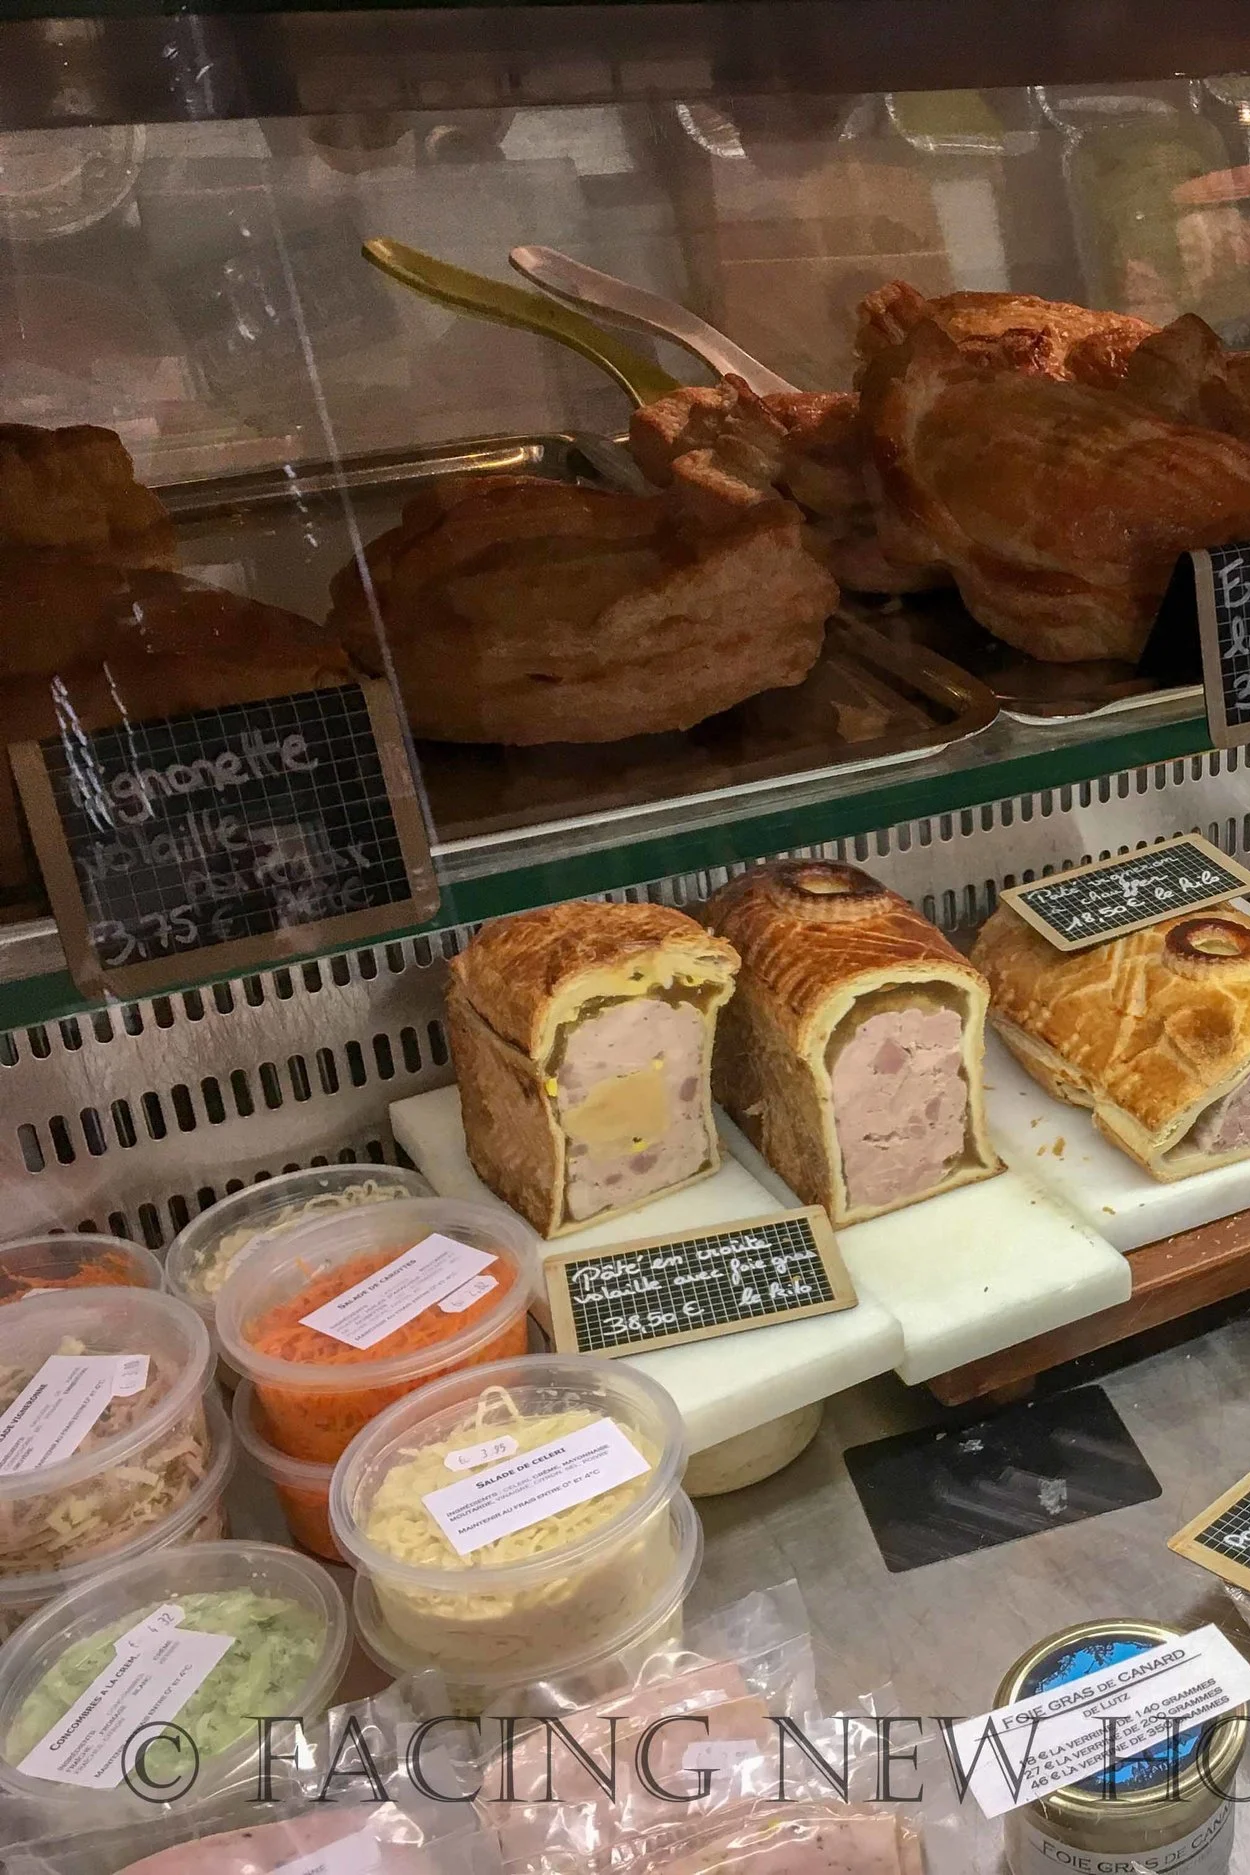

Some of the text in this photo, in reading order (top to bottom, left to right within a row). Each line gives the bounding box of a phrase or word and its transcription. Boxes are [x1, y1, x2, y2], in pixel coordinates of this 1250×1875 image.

[1081, 874, 1169, 905] chauffer
[574, 1250, 818, 1304] volaille avec foie gras
[650, 1254, 683, 1270] en
[695, 1234, 773, 1261] croûte
[603, 1281, 813, 1336] 38,50 € le kilo
[475, 1447, 566, 1490] SALADE DE CELERI
[49, 1695, 102, 1752] CONCOMBRES
[107, 1678, 119, 1690] LA
[1003, 1648, 1187, 1730] FOIE GRAS DE CANARD
[1049, 1741, 1066, 1756] LA
[1065, 1721, 1118, 1750] VERRINE
[1117, 1713, 1135, 1729] DE
[1134, 1702, 1160, 1719] 140
[1161, 1677, 1217, 1708] GRAMMES
[1082, 1692, 1131, 1719] DE LUTZ
[1023, 1766, 1042, 1780] 27
[1055, 1753, 1072, 1767] LA
[1072, 1733, 1123, 1761] VERRINE
[1123, 1724, 1141, 1739] DE
[1140, 1711, 1168, 1728] 200
[1167, 1686, 1223, 1715] GRAMMES
[1030, 1775, 1050, 1791] 46
[1061, 1763, 1079, 1776] LA
[1078, 1744, 1129, 1771] VERRINE
[1128, 1733, 1147, 1751] DE
[1039, 1839, 1092, 1873] FOIE
[1164, 1847, 1186, 1864] DE
[1190, 1803, 1231, 1850] CANA
